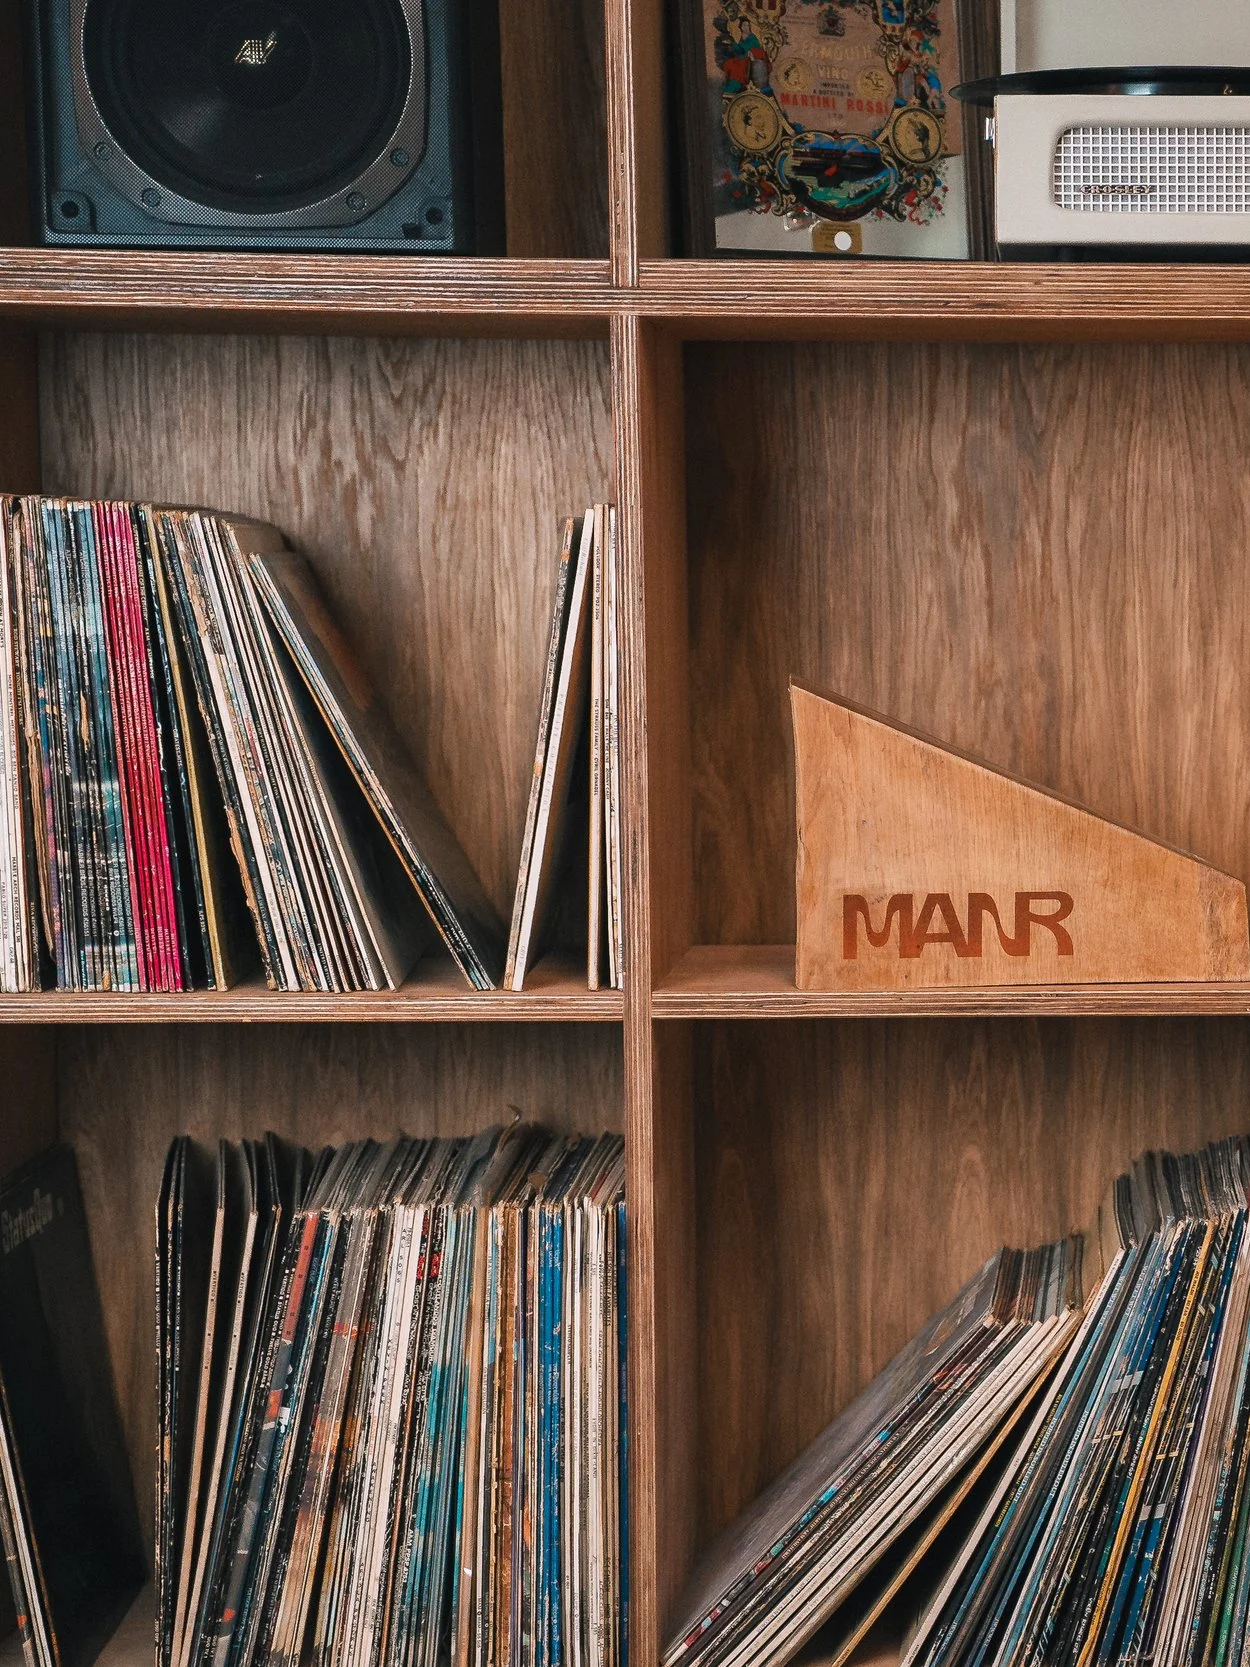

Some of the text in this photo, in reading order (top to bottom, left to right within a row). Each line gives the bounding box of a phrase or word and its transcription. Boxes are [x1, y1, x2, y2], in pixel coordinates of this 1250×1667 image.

[780, 94, 890, 115] MARTINI ROSSI
[1080, 184, 1151, 194] CROSLEY
[132, 524, 142, 559] SUPERTRAMP
[578, 553, 586, 576] Richard
[553, 694, 564, 737] PRIVATE
[122, 888, 131, 916] RECORDS
[842, 891, 1074, 960] MANR
[279, 1275, 287, 1295] VERTIGO
[406, 1330, 415, 1359] MACHINE
[1039, 1417, 1057, 1446] POPPED
[1072, 1410, 1089, 1441] POPPED
[1020, 1456, 1038, 1485] SOULED
[1055, 1451, 1072, 1482] SOULED
[406, 1529, 414, 1546] A&M
[1226, 1565, 1238, 1615] ATLANTIC RECORDS
